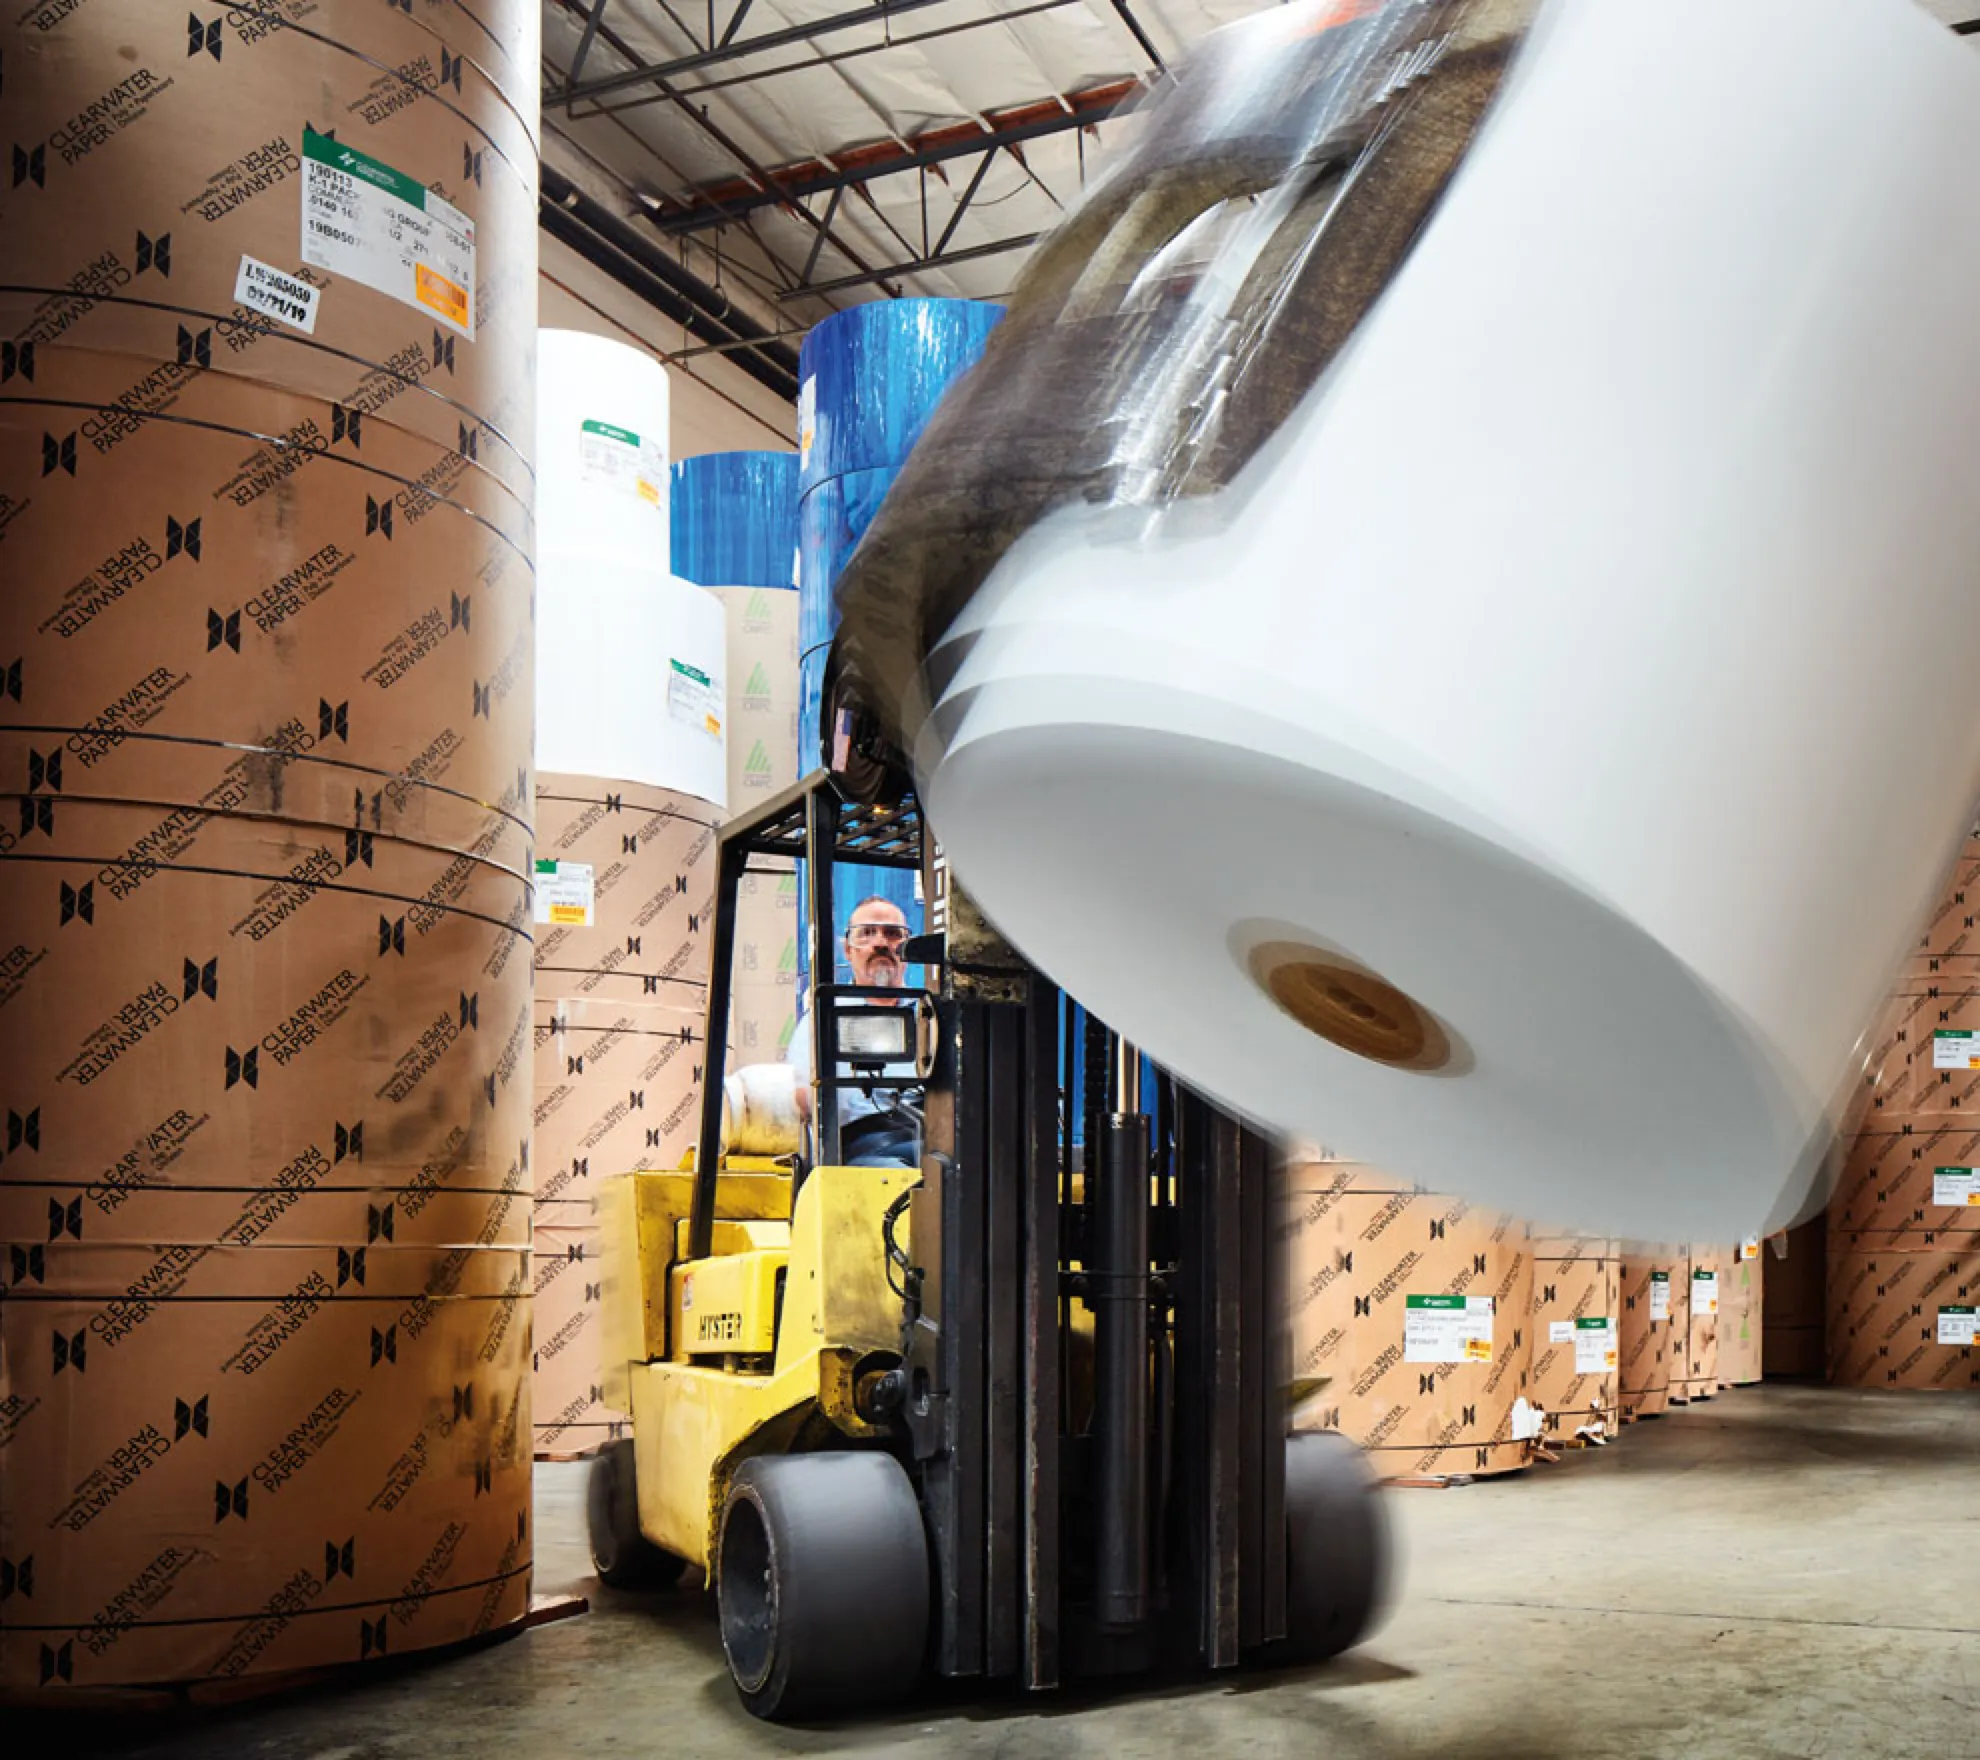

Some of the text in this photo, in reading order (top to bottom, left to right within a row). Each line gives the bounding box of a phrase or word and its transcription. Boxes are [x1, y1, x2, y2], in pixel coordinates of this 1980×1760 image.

[49, 68, 158, 150] CLEARWATER
[61, 122, 115, 166] PAPER
[239, 136, 291, 174] PAPER
[196, 152, 302, 222] CLEARWATER
[96, 536, 151, 579] PAPER
[243, 543, 344, 618] CLEARWATER
[51, 553, 163, 638] CLEARWATER
[255, 594, 307, 634] PAPER
[405, 606, 443, 641] PAPER
[372, 621, 449, 689] CLEARWATER
[112, 980, 168, 1025] PAPER
[261, 969, 358, 1053] CLEARWATER
[70, 995, 180, 1085] CLEARWATER
[271, 1022, 322, 1066] PAPER
[386, 1024, 459, 1103] CLEARWATER
[272, 1143, 322, 1188] PAPER
[698, 1311, 742, 1341] HYSTER
[107, 1423, 159, 1469] PAPER
[251, 1388, 350, 1482] CLEARWATER
[61, 1437, 171, 1532] CLEARWATER
[263, 1450, 313, 1494] PAPER
